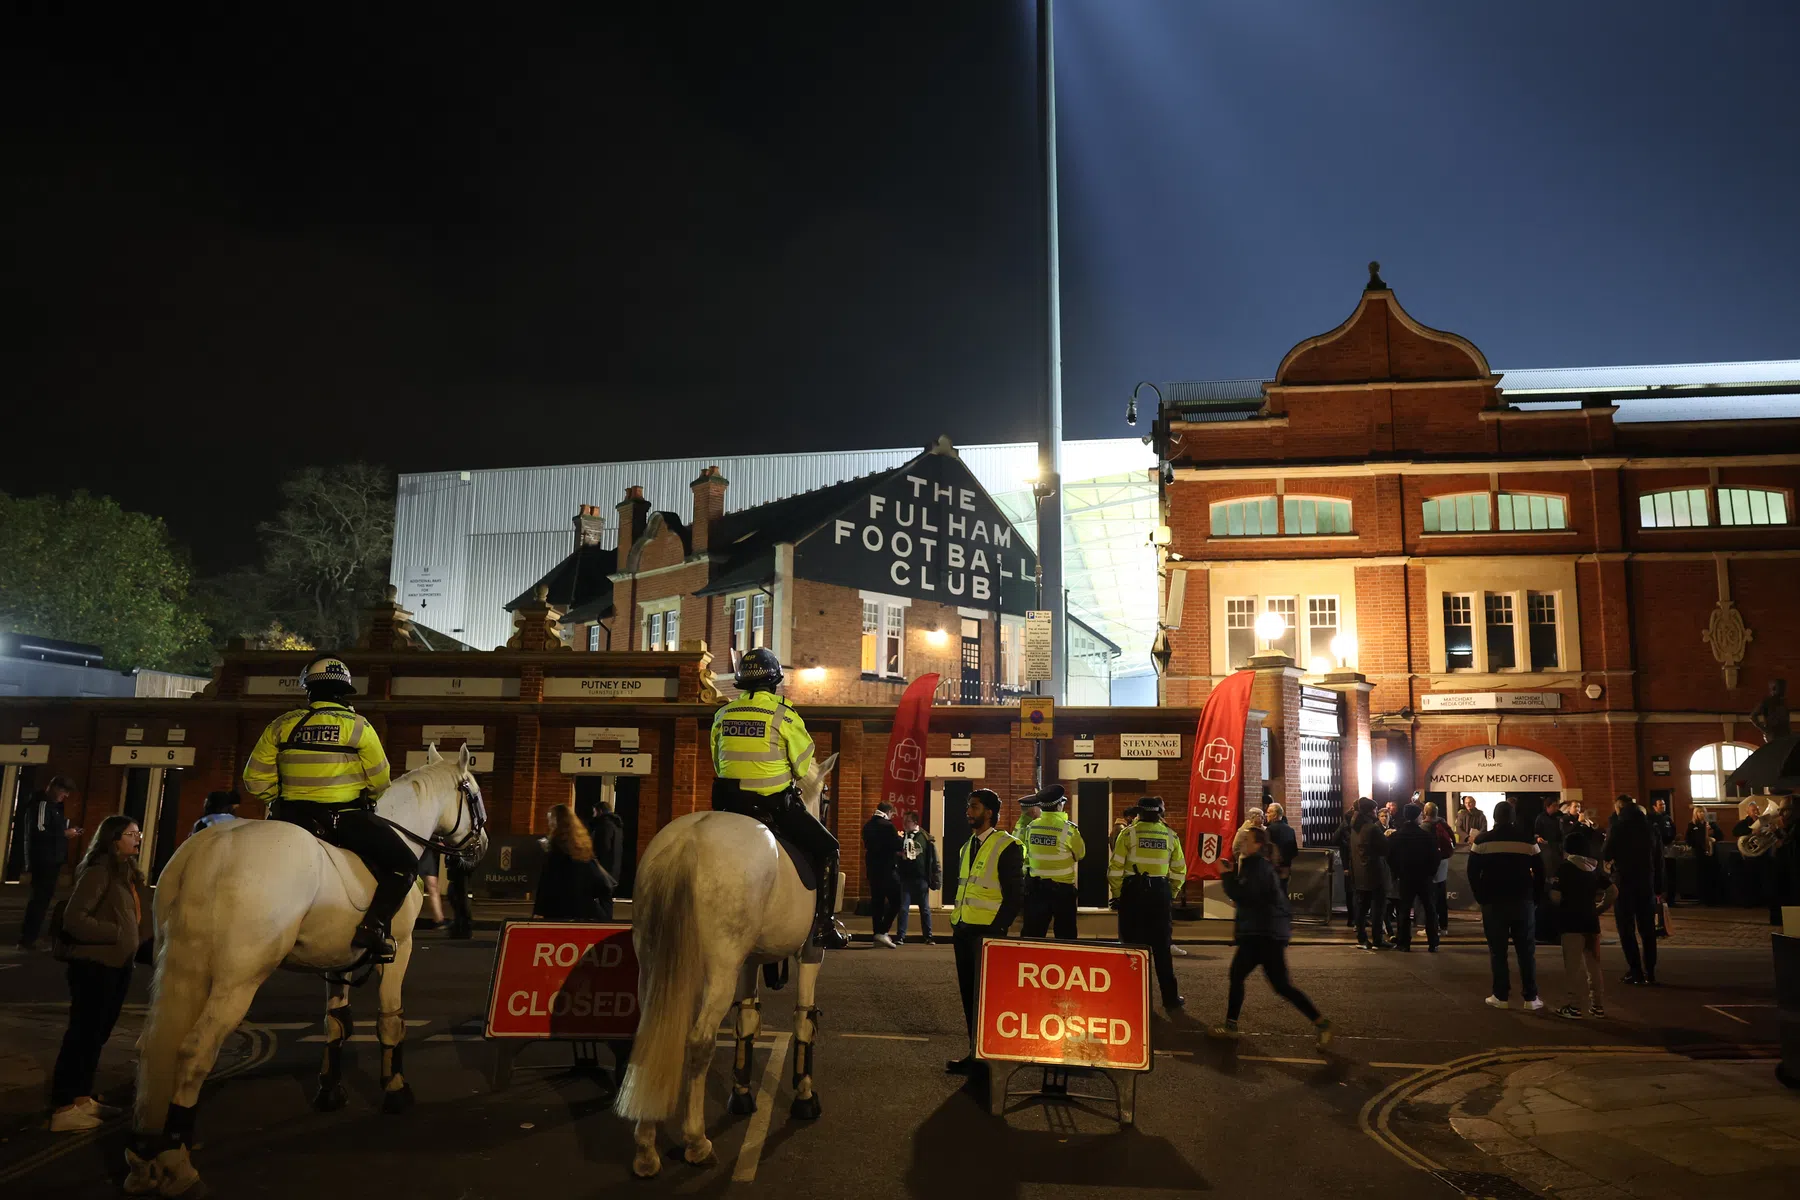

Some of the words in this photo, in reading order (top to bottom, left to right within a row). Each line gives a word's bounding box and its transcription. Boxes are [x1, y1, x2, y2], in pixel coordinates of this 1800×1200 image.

[907, 475, 975, 512] THE
[869, 494, 1011, 548] FULHAM
[835, 519, 1036, 581] FOOTBALL
[890, 560, 991, 600] CLUB
[581, 680, 619, 689] PUTNEY
[622, 680, 642, 689] END
[294, 730, 338, 742] POLICE
[723, 726, 764, 736] POLICE
[20, 748, 28, 757] 4
[130, 750, 137, 759] 5
[167, 750, 174, 759] 6
[469, 756, 476, 766] 0
[579, 757, 591, 767] 11
[620, 758, 633, 768] 12
[950, 762, 965, 772] 16
[1084, 763, 1099, 773] 17
[1430, 775, 1484, 783] MATCHDAY
[1487, 775, 1518, 783] MEDIA
[1520, 774, 1553, 783] OFFICE
[889, 792, 916, 805] BAG
[1199, 793, 1228, 806] BAG
[1193, 807, 1231, 821] LANE
[532, 942, 623, 967] ROAD
[1018, 962, 1111, 992] ROAD
[508, 990, 636, 1016] CLOSED
[996, 1011, 1132, 1045] CLOSED
